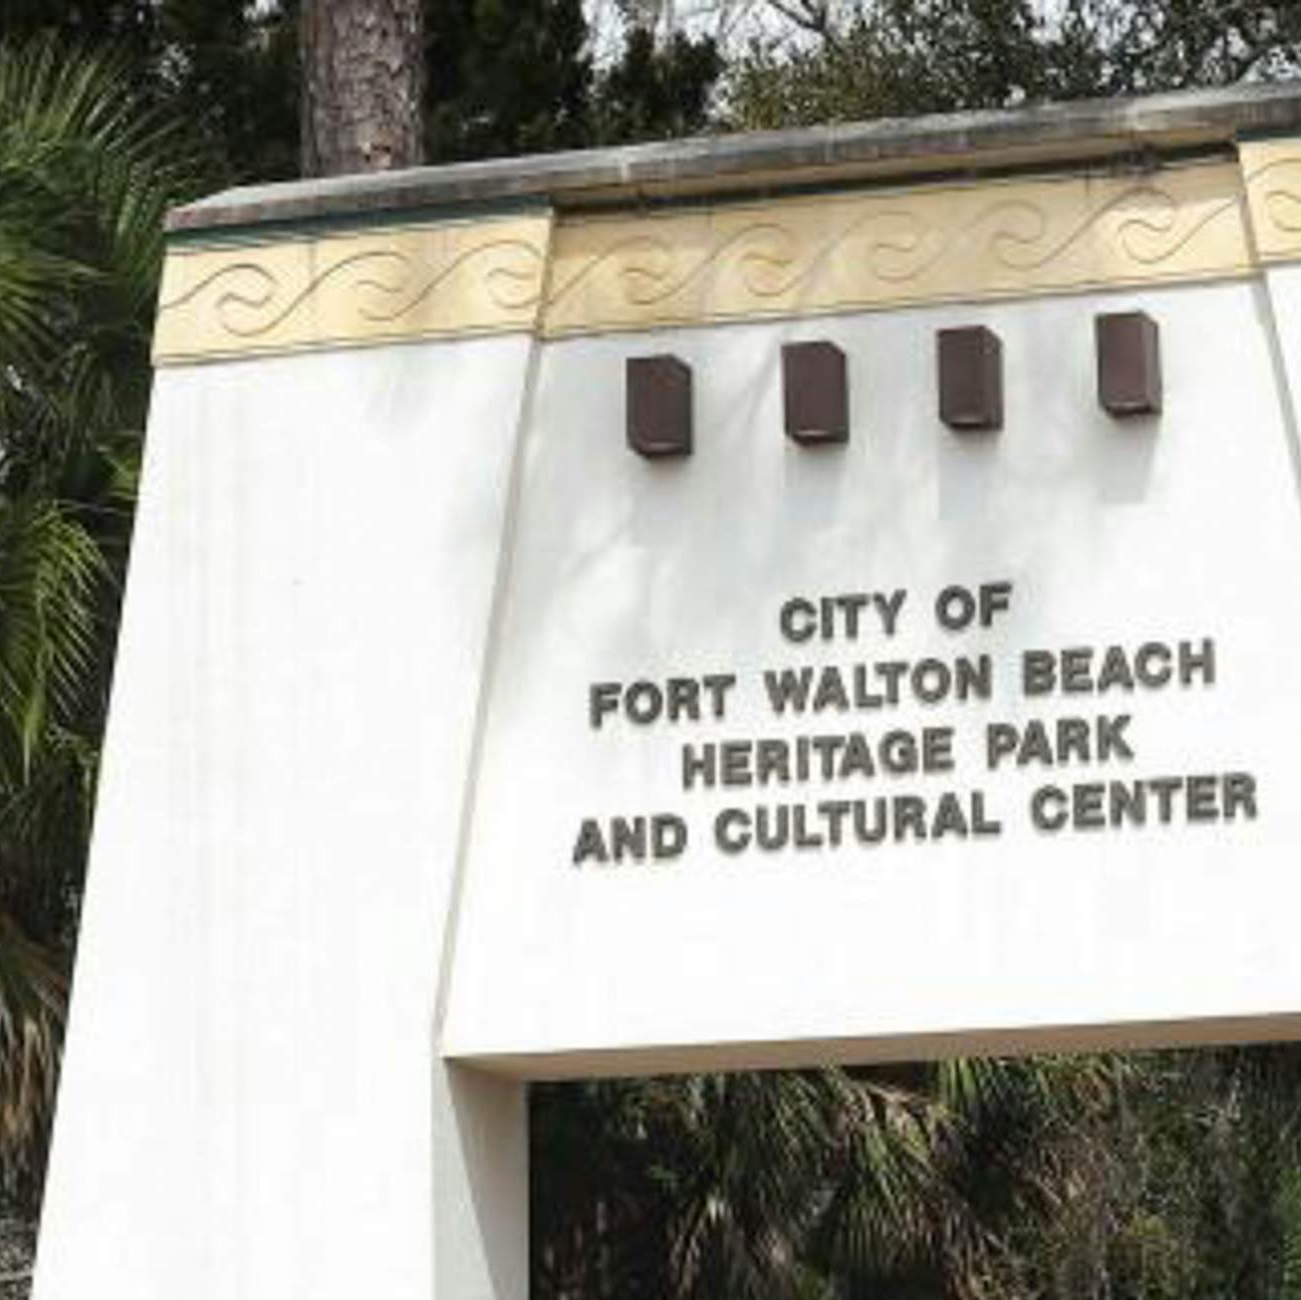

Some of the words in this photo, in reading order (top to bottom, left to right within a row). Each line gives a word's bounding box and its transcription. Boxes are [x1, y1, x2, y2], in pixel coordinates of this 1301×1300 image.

[779, 589, 908, 645] CITY
[934, 581, 1013, 633] OF
[589, 674, 737, 730] FORT
[764, 653, 993, 716] WALTON
[1022, 638, 1216, 698] BEACH
[682, 727, 955, 791] HERITAGE
[987, 714, 1135, 770] PARK
[572, 813, 688, 866] AND
[714, 791, 1002, 856] CULTURAL
[1031, 772, 1258, 833] CENTER
